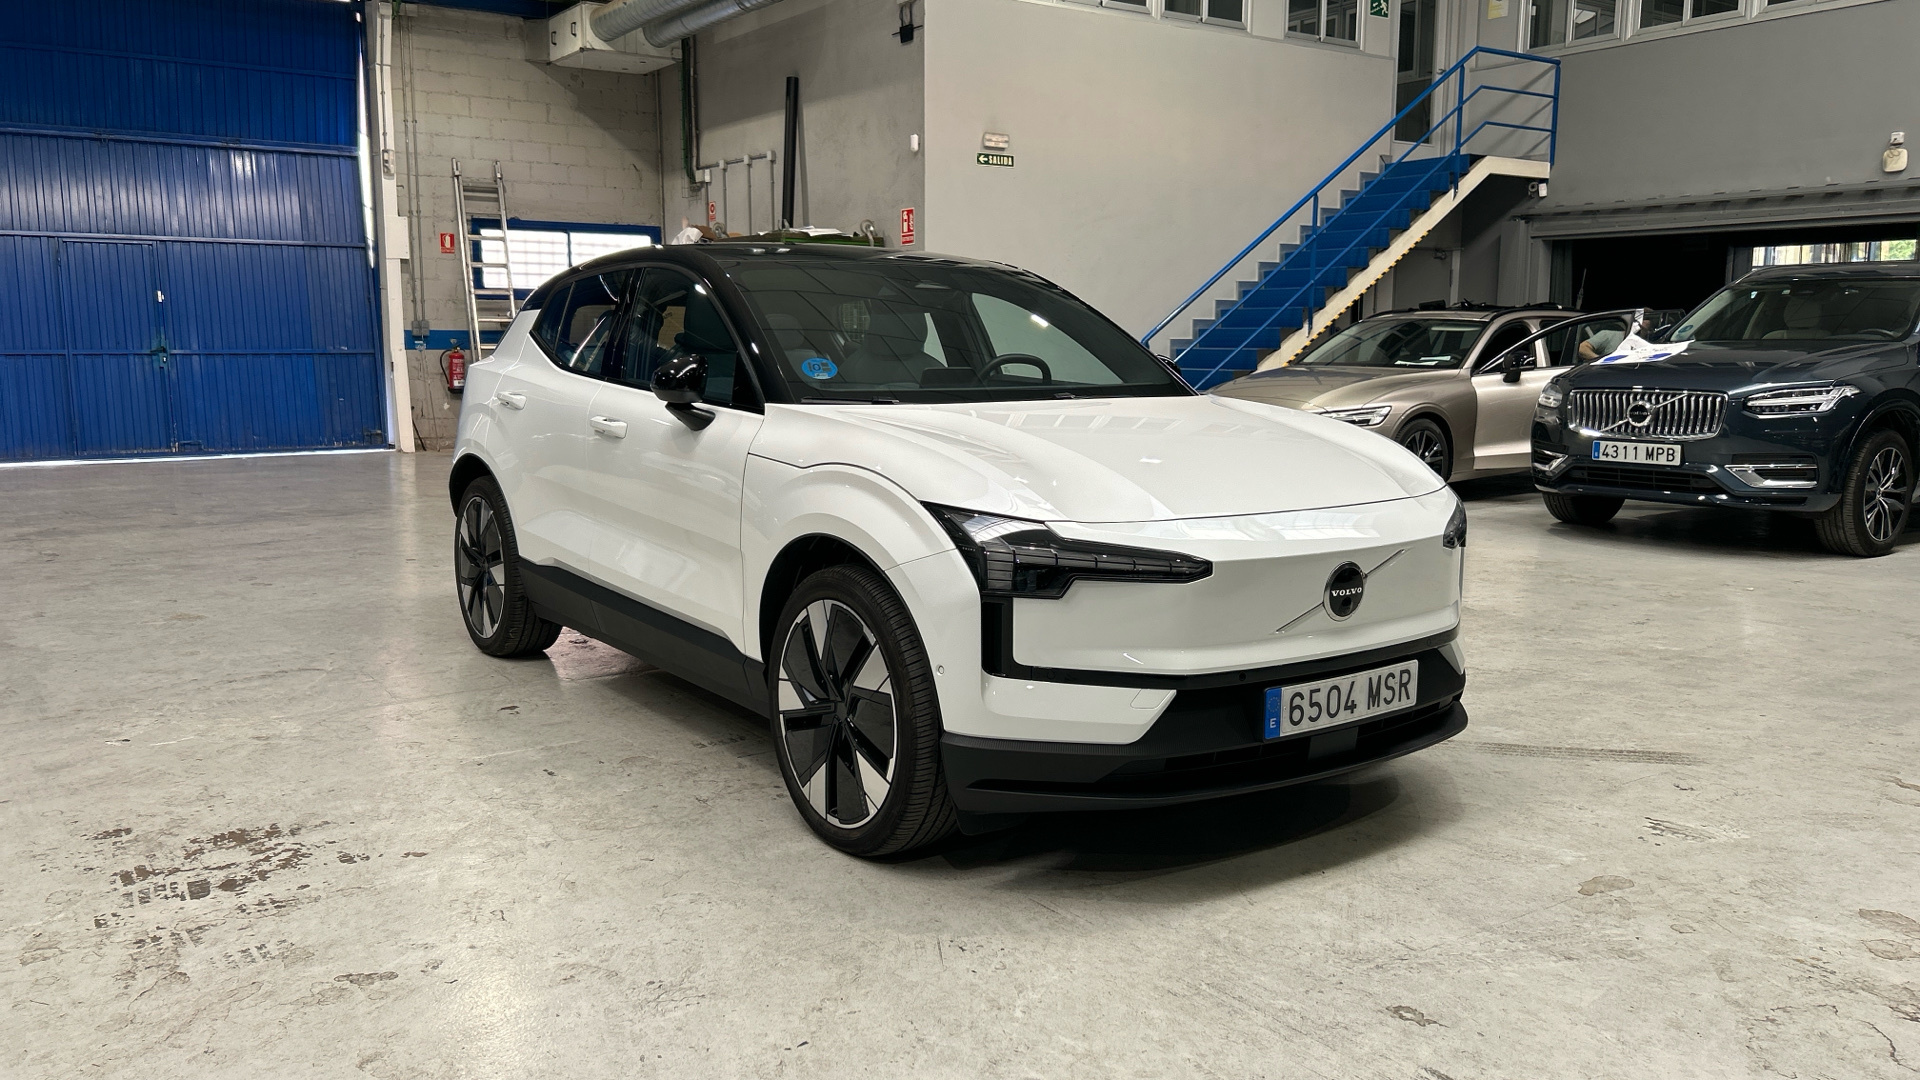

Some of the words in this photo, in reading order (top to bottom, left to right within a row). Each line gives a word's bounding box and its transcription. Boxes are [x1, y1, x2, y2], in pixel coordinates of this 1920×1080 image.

[989, 155, 1012, 165] SALIDA
[1602, 444, 1638, 460] 4311
[1645, 446, 1675, 462] MPB
[1331, 587, 1362, 597] VOLVO
[1289, 681, 1357, 727] 6504
[1367, 669, 1411, 710] MSR
[1269, 717, 1277, 728] E
